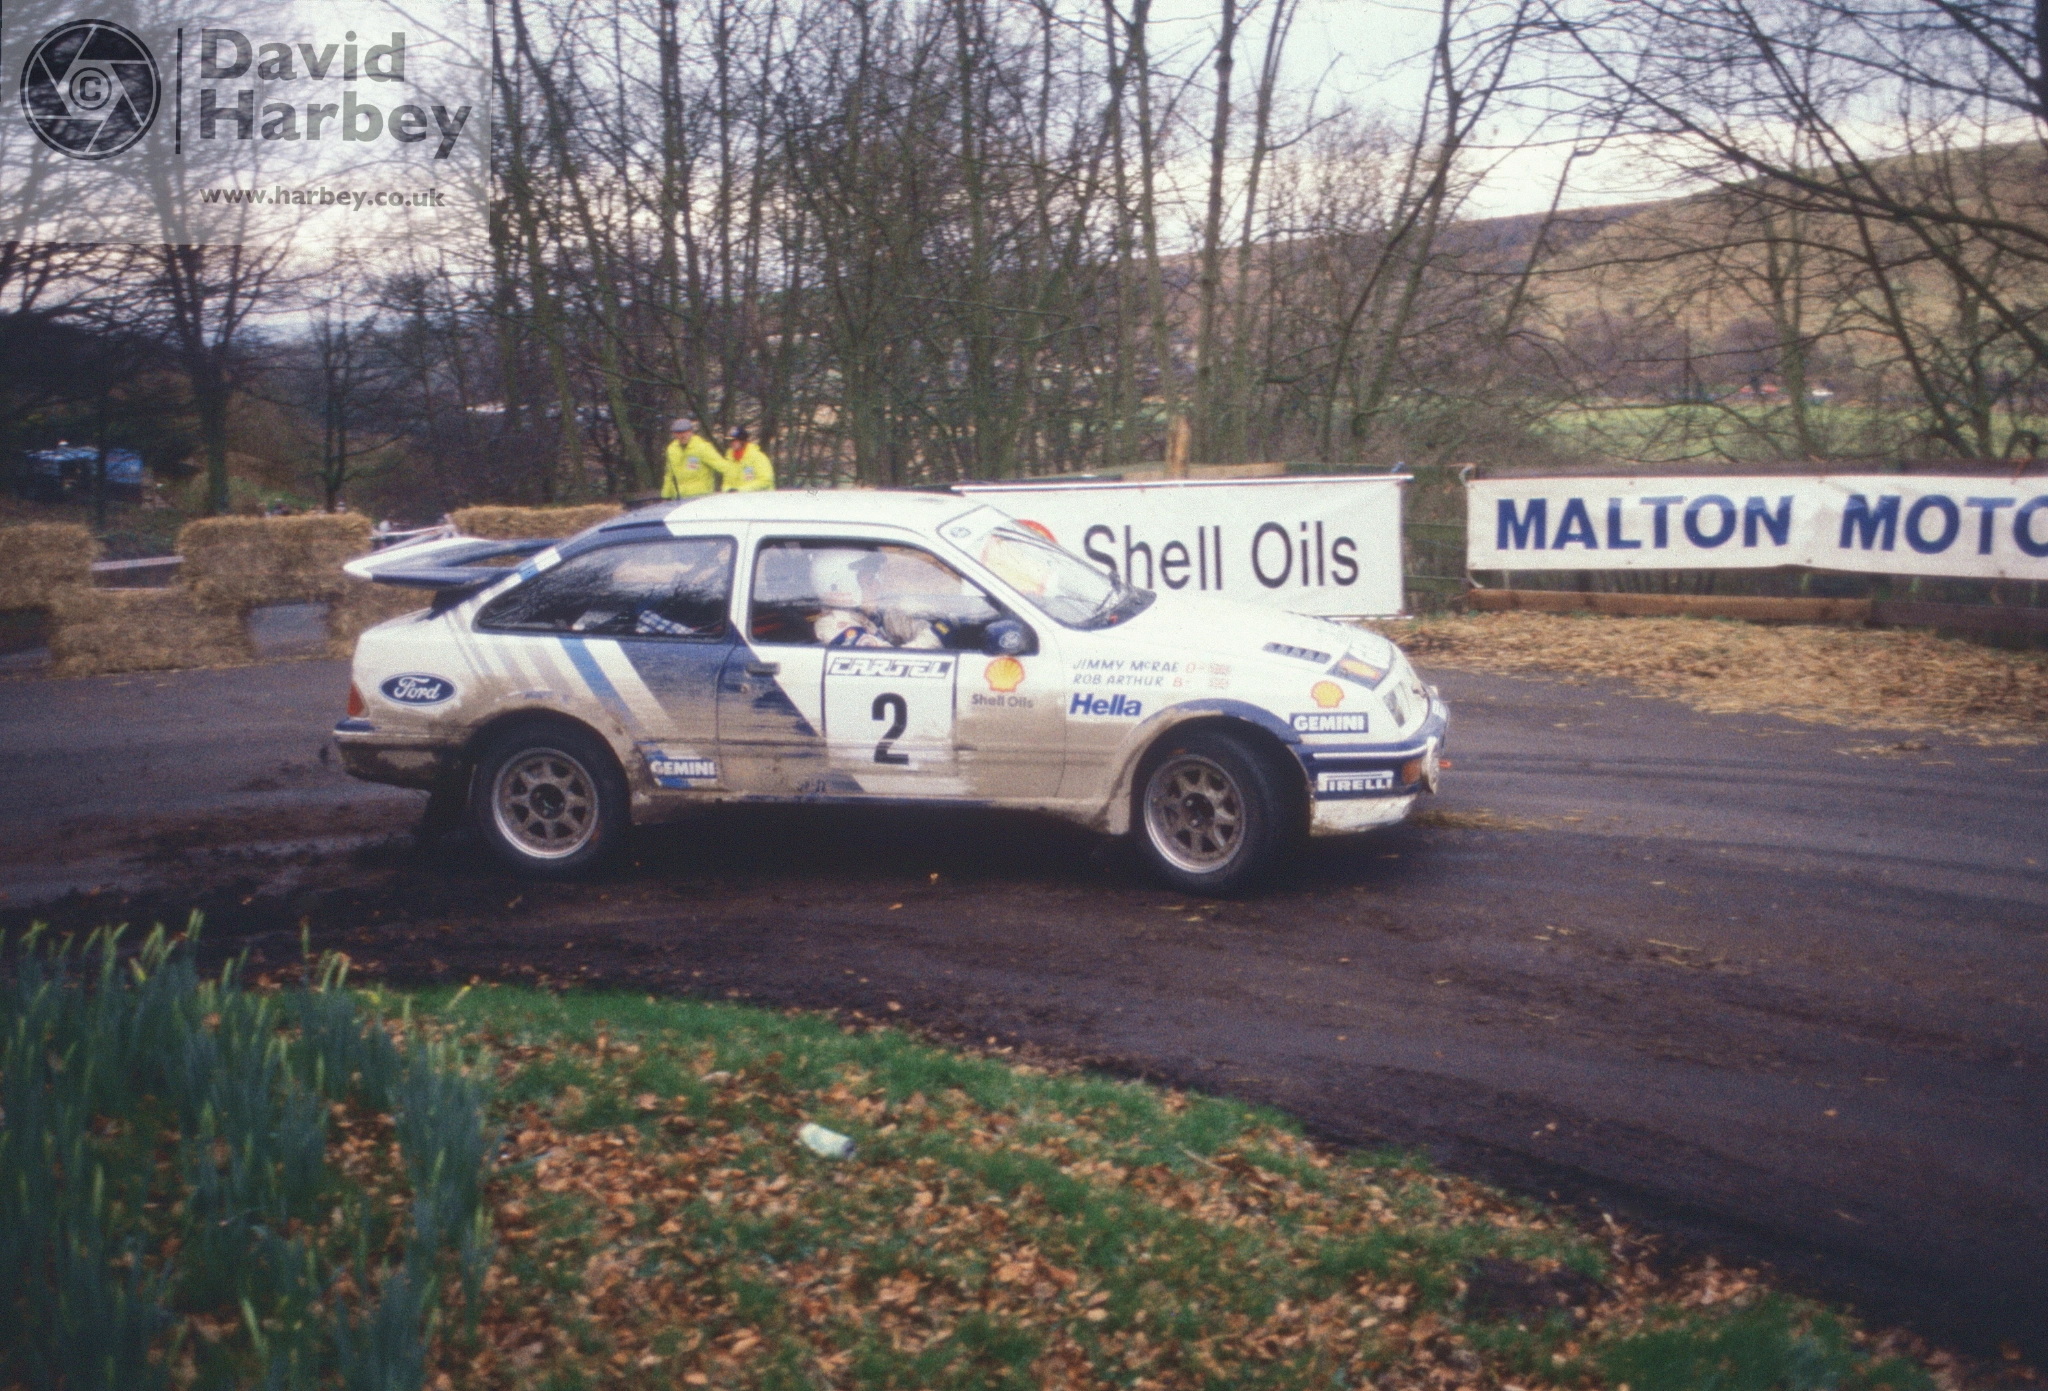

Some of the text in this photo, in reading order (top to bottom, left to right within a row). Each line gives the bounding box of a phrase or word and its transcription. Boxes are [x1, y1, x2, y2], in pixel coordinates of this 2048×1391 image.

[1496, 494, 1795, 551] MALTON
[1083, 520, 1359, 591] Shell Oils
[828, 657, 953, 679] CARTEL
[1072, 659, 1125, 670] JIMMY
[393, 676, 442, 699] Ford
[1073, 674, 1102, 685] ROB
[1106, 675, 1164, 687] ARTHUR
[971, 693, 1034, 708] Shell Oils
[1069, 692, 1143, 716] Hella
[871, 692, 909, 765] 2
[1293, 715, 1366, 731] GEMINI
[651, 760, 716, 776] GEMINI
[1317, 770, 1394, 792] PIRELLI
